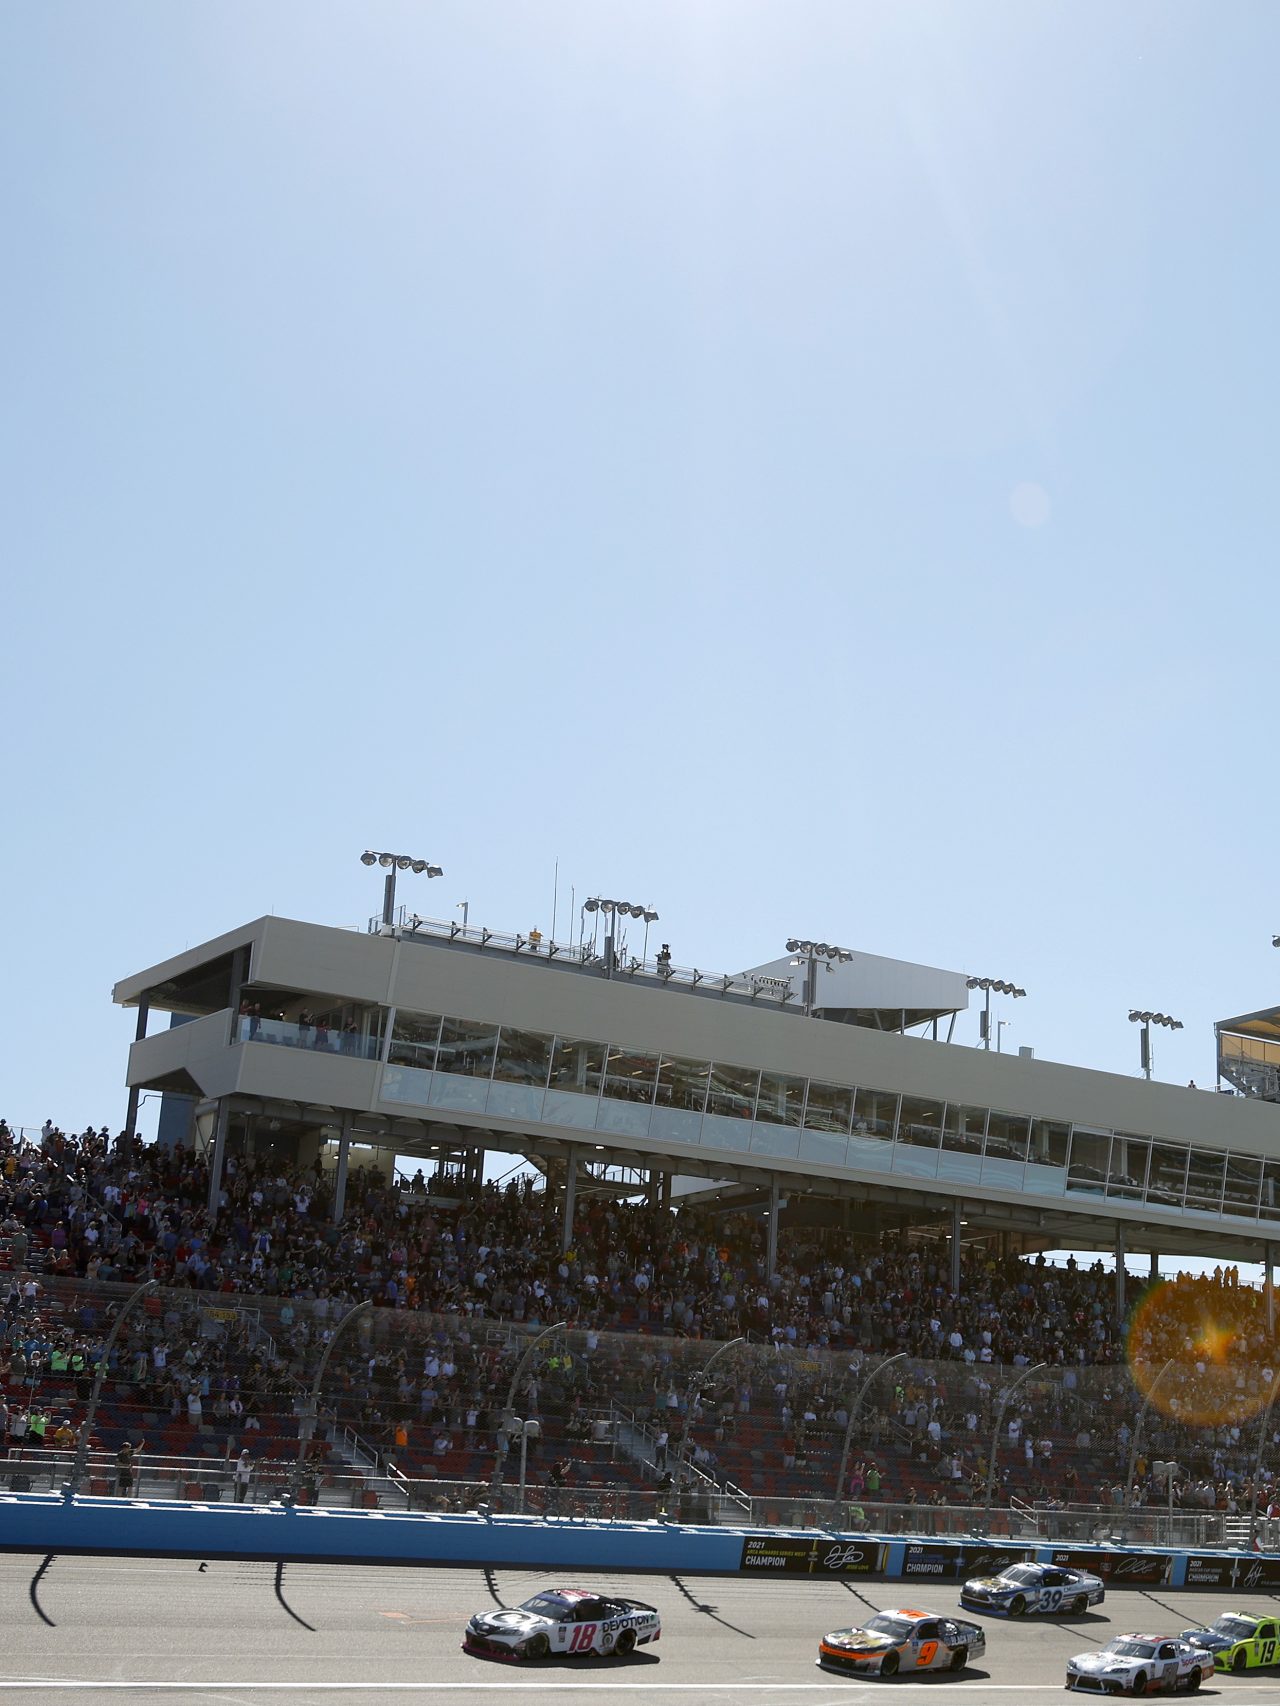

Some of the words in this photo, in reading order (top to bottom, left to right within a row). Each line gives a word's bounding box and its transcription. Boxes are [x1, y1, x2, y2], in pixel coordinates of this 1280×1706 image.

[747, 1541, 765, 1549] 2021
[745, 1556, 787, 1567] CHAMPION
[906, 1563, 944, 1573] CHAMPION
[1039, 1590, 1064, 1612] 39
[602, 1615, 650, 1633] DEVOTION
[567, 1623, 598, 1653] 18
[916, 1641, 938, 1666] 9
[1260, 1641, 1276, 1664] 19
